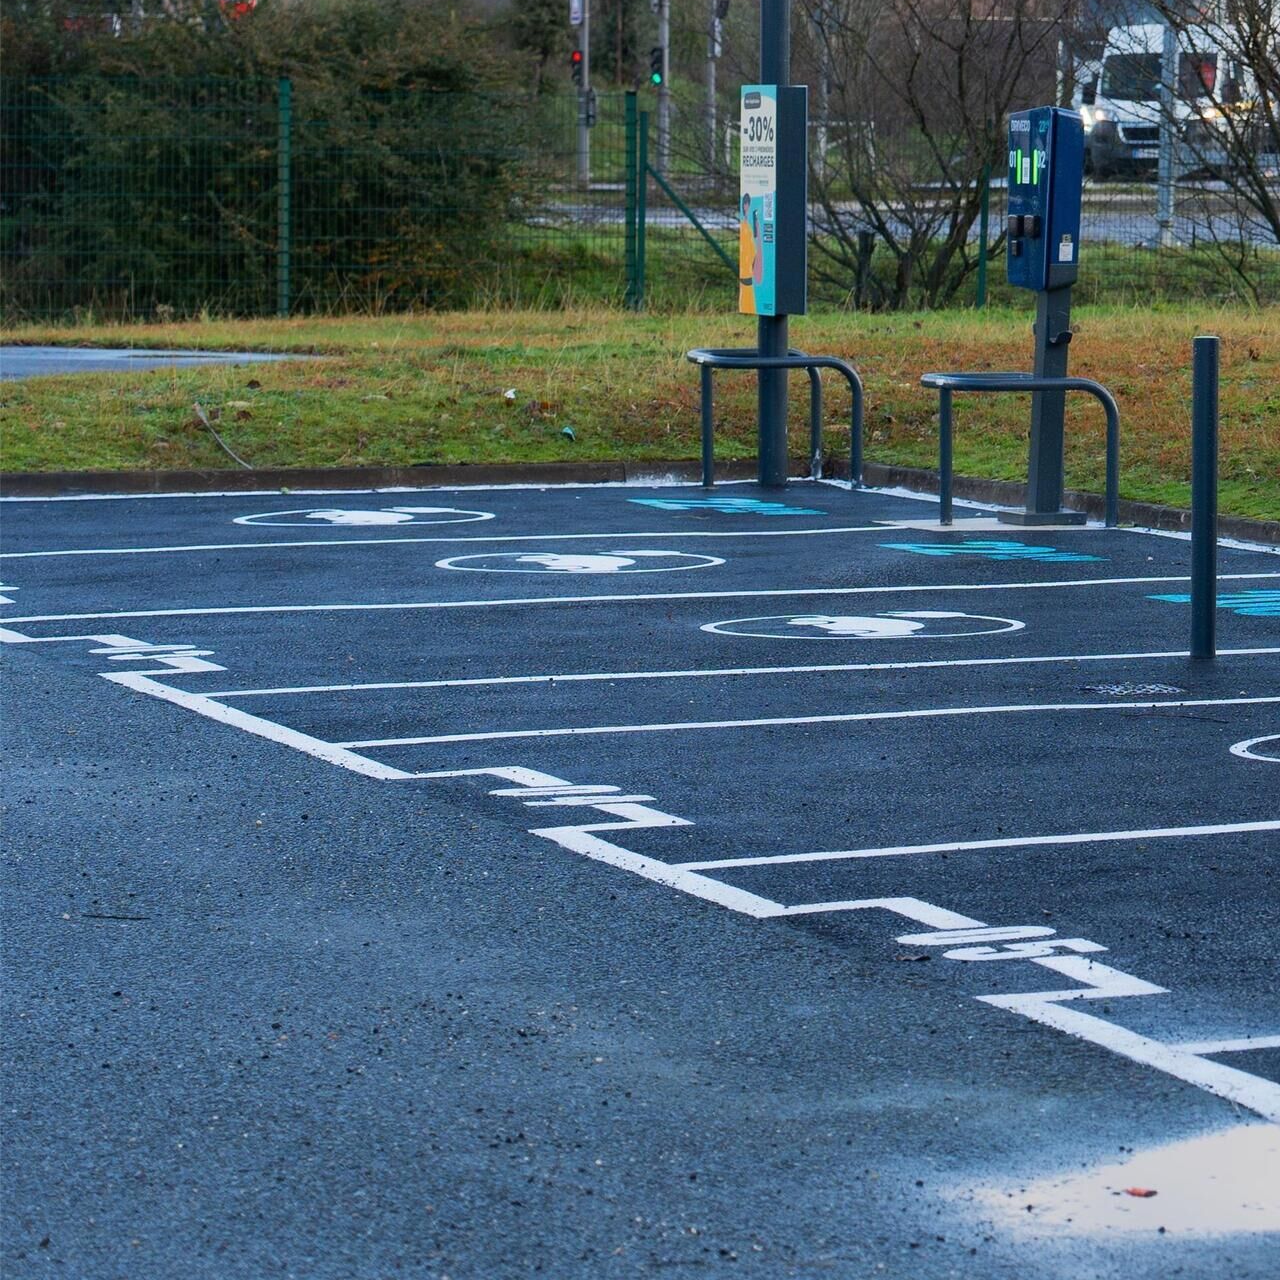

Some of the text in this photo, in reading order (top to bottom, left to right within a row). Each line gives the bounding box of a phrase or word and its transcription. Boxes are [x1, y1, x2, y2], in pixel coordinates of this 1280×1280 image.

[743, 115, 774, 142] -30%
[1011, 119, 1030, 132] DRIVECO
[743, 155, 774, 167] RECHARGES
[1009, 150, 1016, 168] 01
[488, 784, 657, 806] 04
[895, 925, 1109, 961] 05
